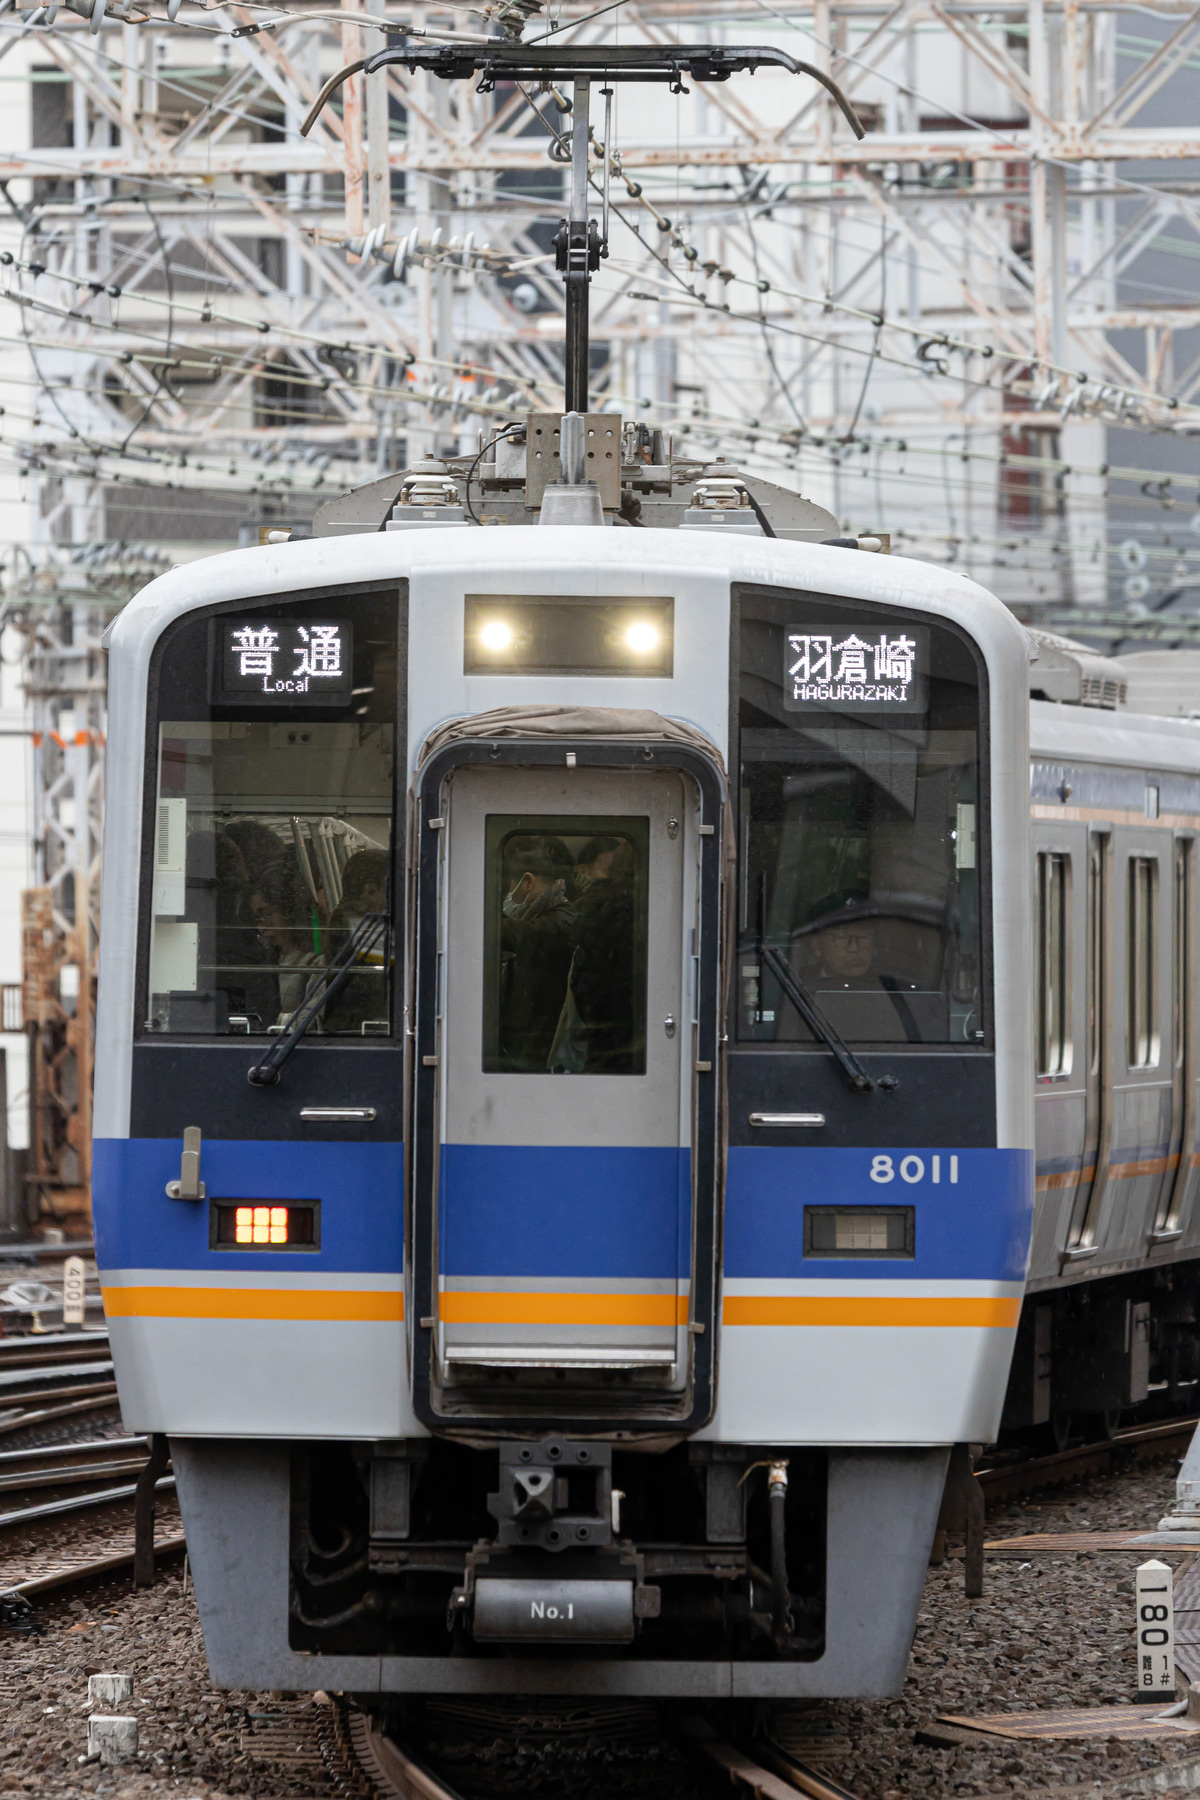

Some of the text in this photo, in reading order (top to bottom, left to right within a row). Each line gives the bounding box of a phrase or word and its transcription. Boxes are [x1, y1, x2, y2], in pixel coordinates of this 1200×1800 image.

[231, 625, 343, 677] 普通
[788, 634, 916, 684] 羽倉崎
[262, 676, 309, 692] Local
[793, 684, 908, 701] HAGURAZAKI
[869, 1154, 958, 1184] 8011
[67, 1268, 81, 1300] 400
[530, 1600, 574, 1620] No.1
[1140, 1586, 1169, 1646] 180
